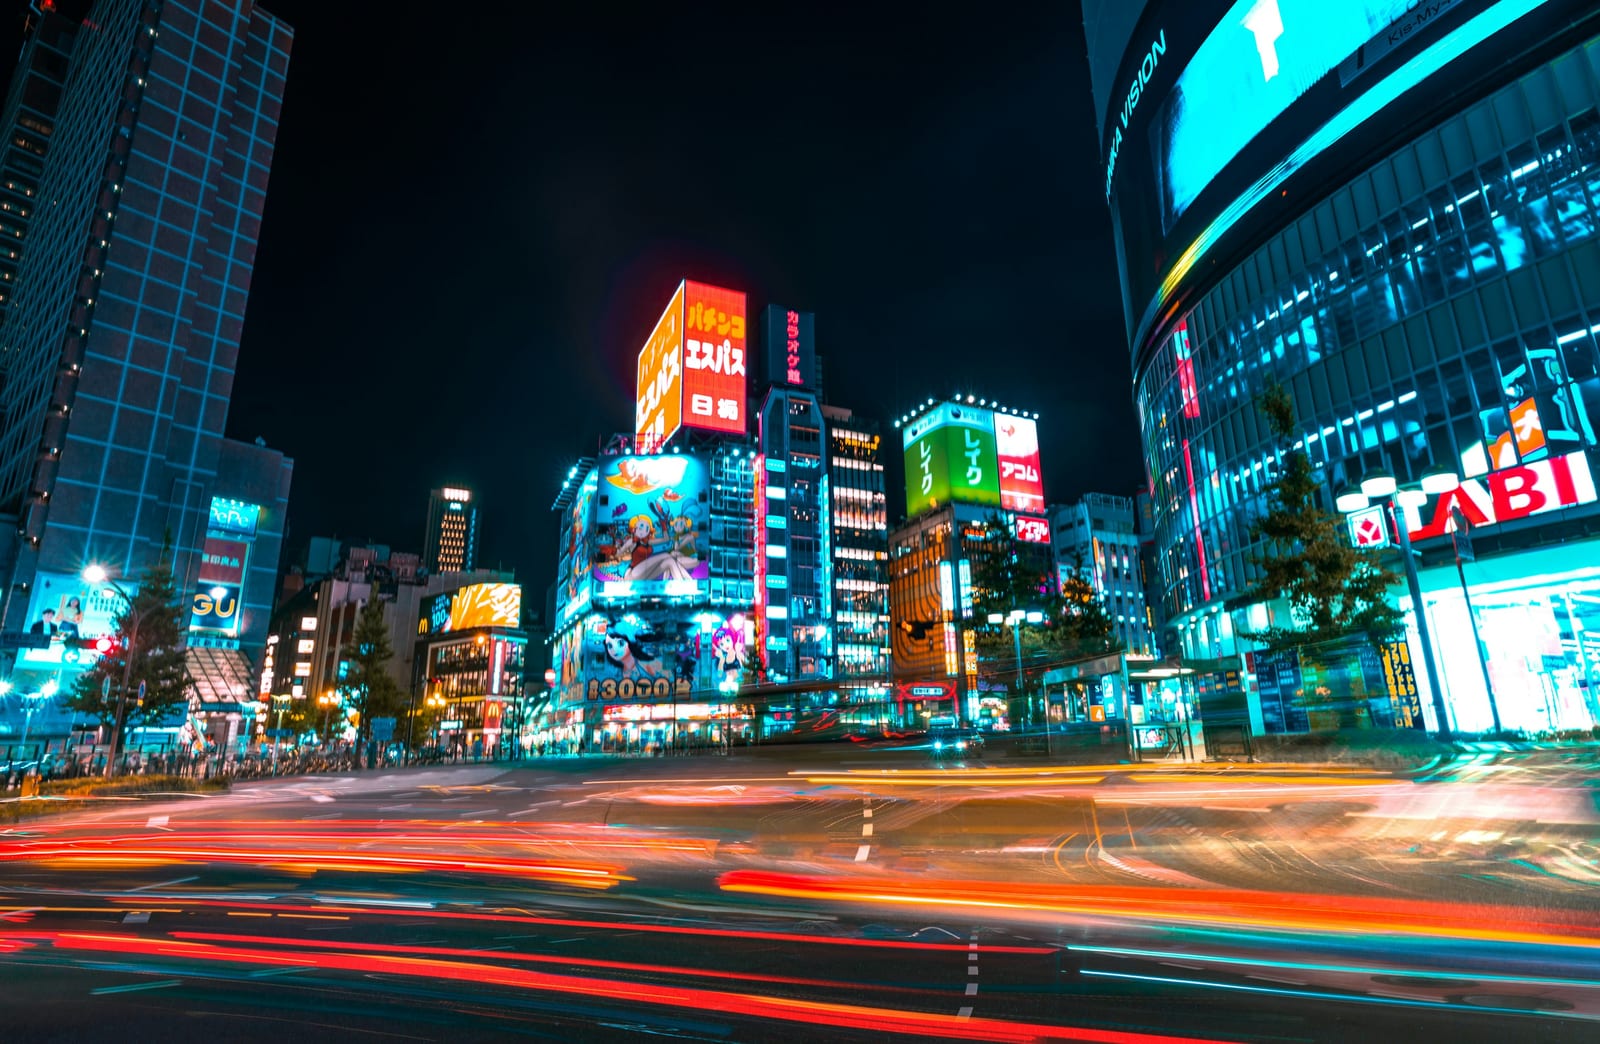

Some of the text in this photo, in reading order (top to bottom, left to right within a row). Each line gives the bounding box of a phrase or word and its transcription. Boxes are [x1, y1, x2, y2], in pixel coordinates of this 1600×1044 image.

[1120, 29, 1168, 129] VISION
[687, 301, 745, 339] パチンコ
[685, 338, 746, 376] エスパス
[919, 440, 933, 496] レイク
[964, 428, 982, 486] レイク
[1001, 461, 1039, 483] アコム
[192, 593, 236, 619] GU
